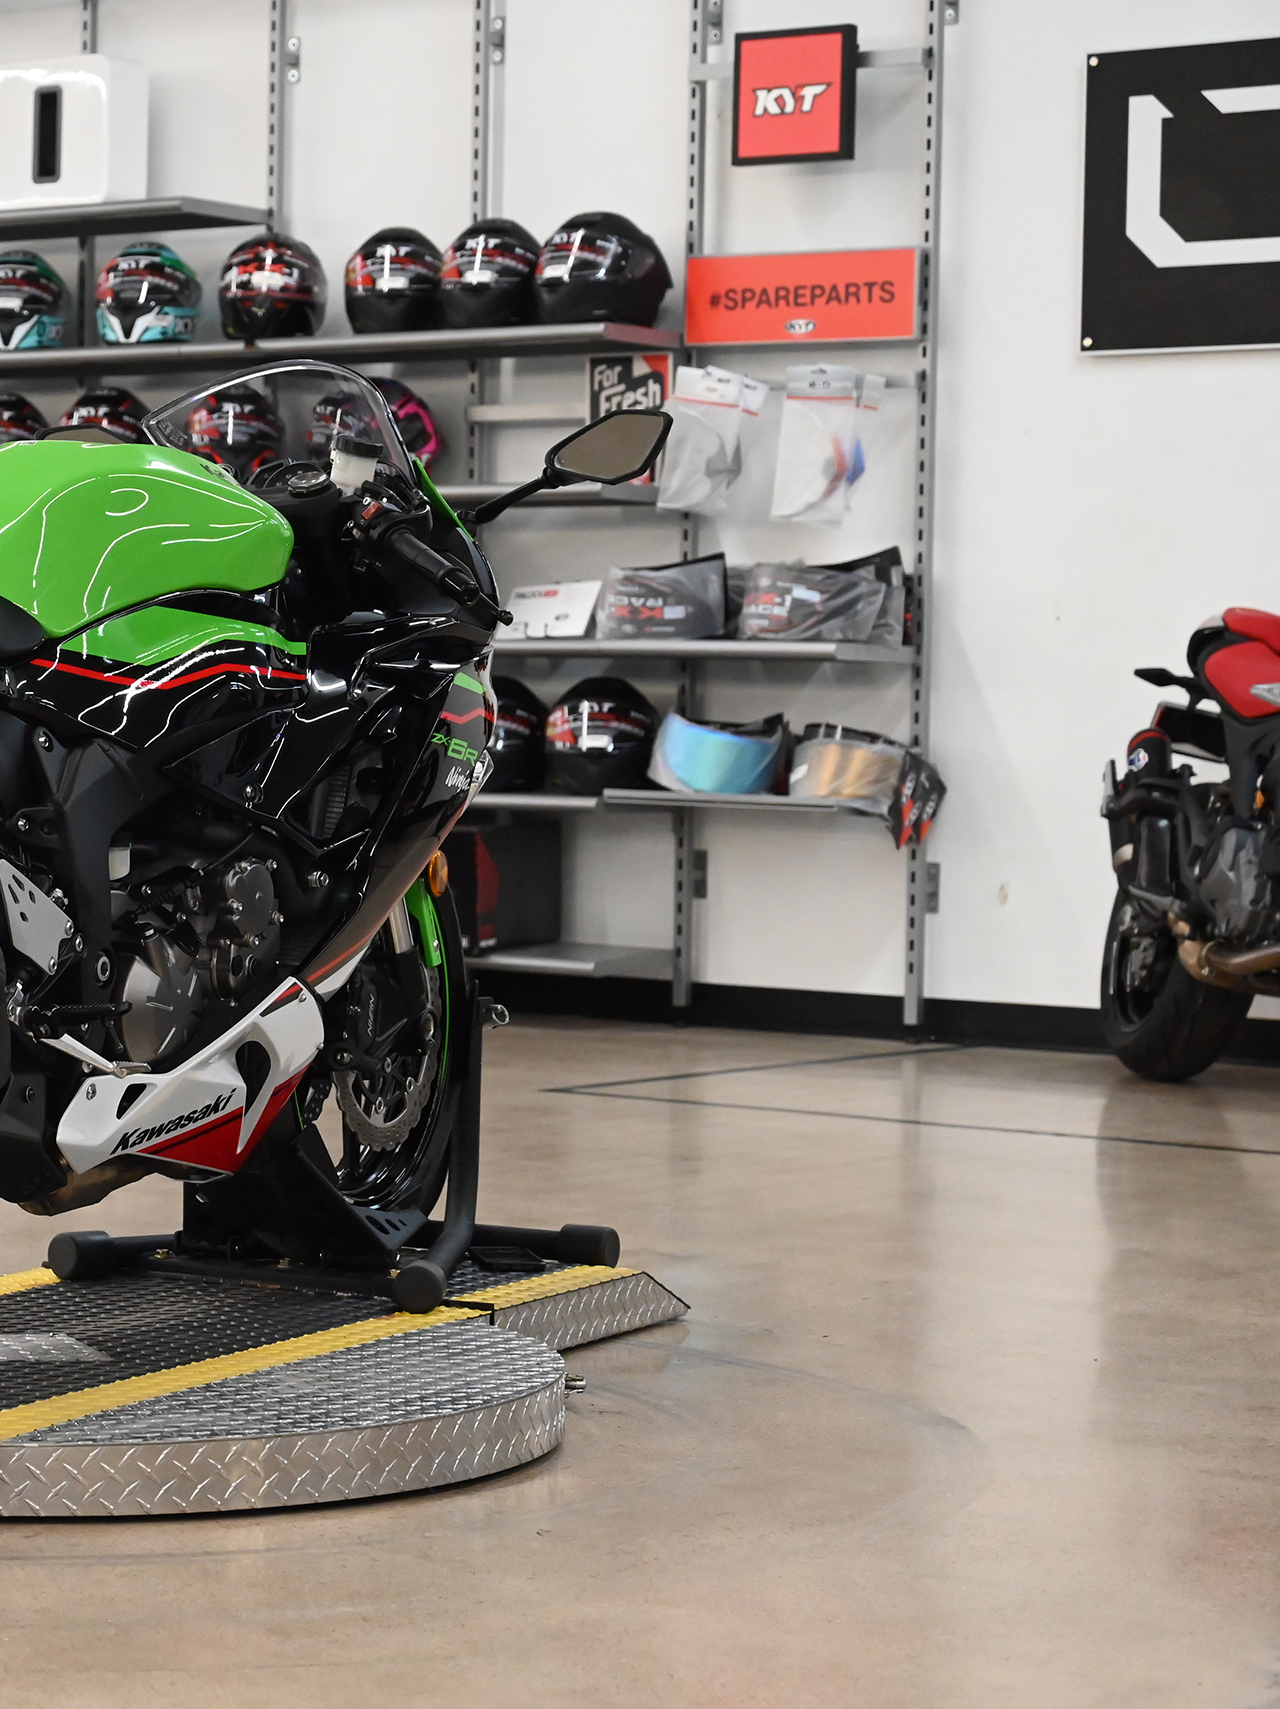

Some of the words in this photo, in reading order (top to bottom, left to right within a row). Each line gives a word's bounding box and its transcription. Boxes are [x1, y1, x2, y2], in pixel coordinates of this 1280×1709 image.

[753, 83, 832, 117] KYT
[709, 280, 896, 311] #SPAREPARTS
[593, 364, 623, 391] For
[599, 378, 662, 417] Fresh
[431, 732, 479, 767] ZX-6R
[445, 765, 471, 794] Ninja
[109, 1087, 238, 1156] Kawasaki
